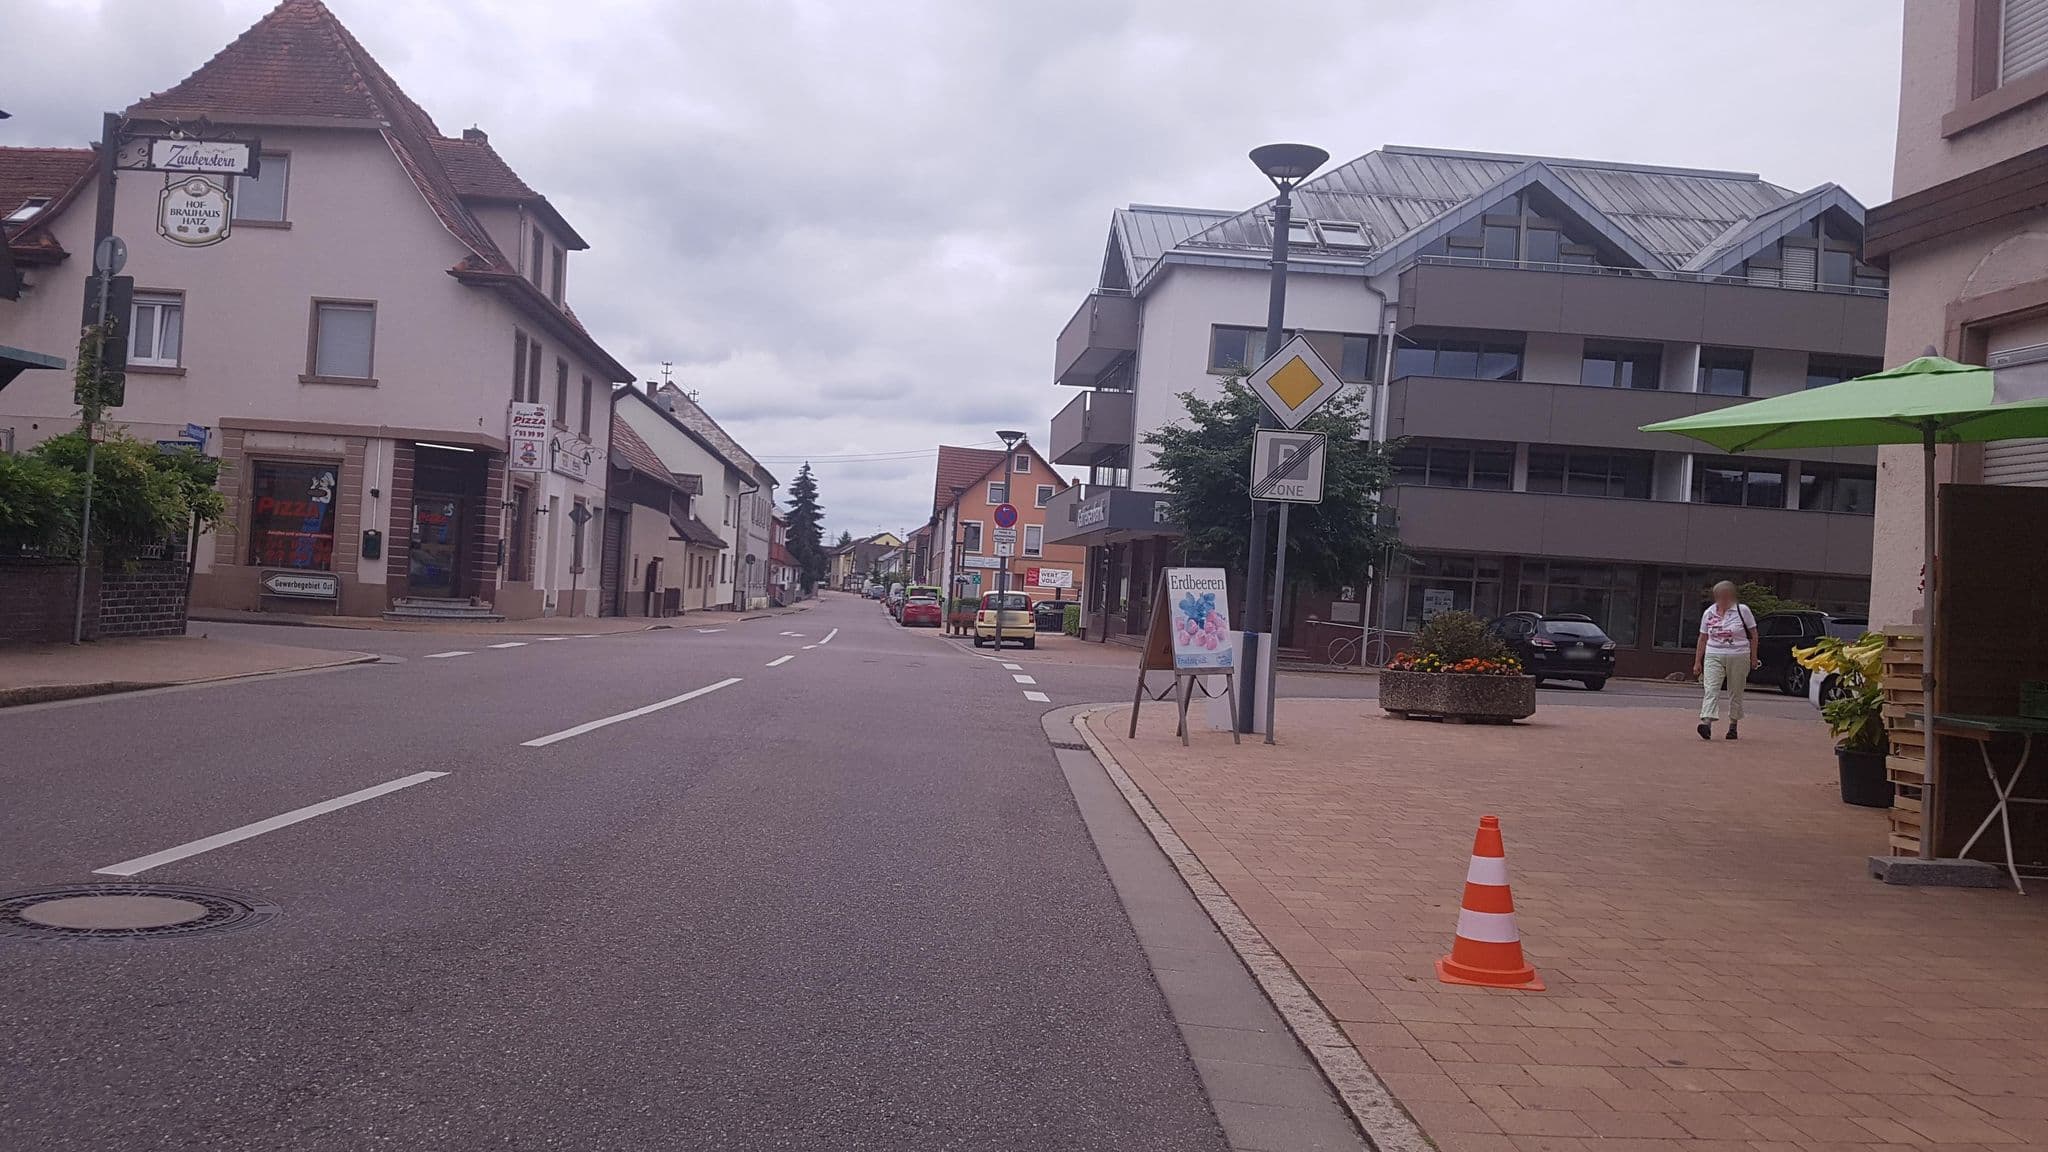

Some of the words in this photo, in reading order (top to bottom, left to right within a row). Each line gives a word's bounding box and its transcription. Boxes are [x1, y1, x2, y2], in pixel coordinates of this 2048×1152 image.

[164, 144, 236, 168] Zauberstern
[182, 217, 207, 226] HATZ
[514, 416, 546, 425] PIZZA
[1269, 484, 1304, 497] ZONE
[257, 496, 320, 517] PIZZA
[274, 579, 320, 591] Gewerbegebiet
[322, 582, 333, 590] Ost
[1170, 574, 1225, 591] Erdbeeren
